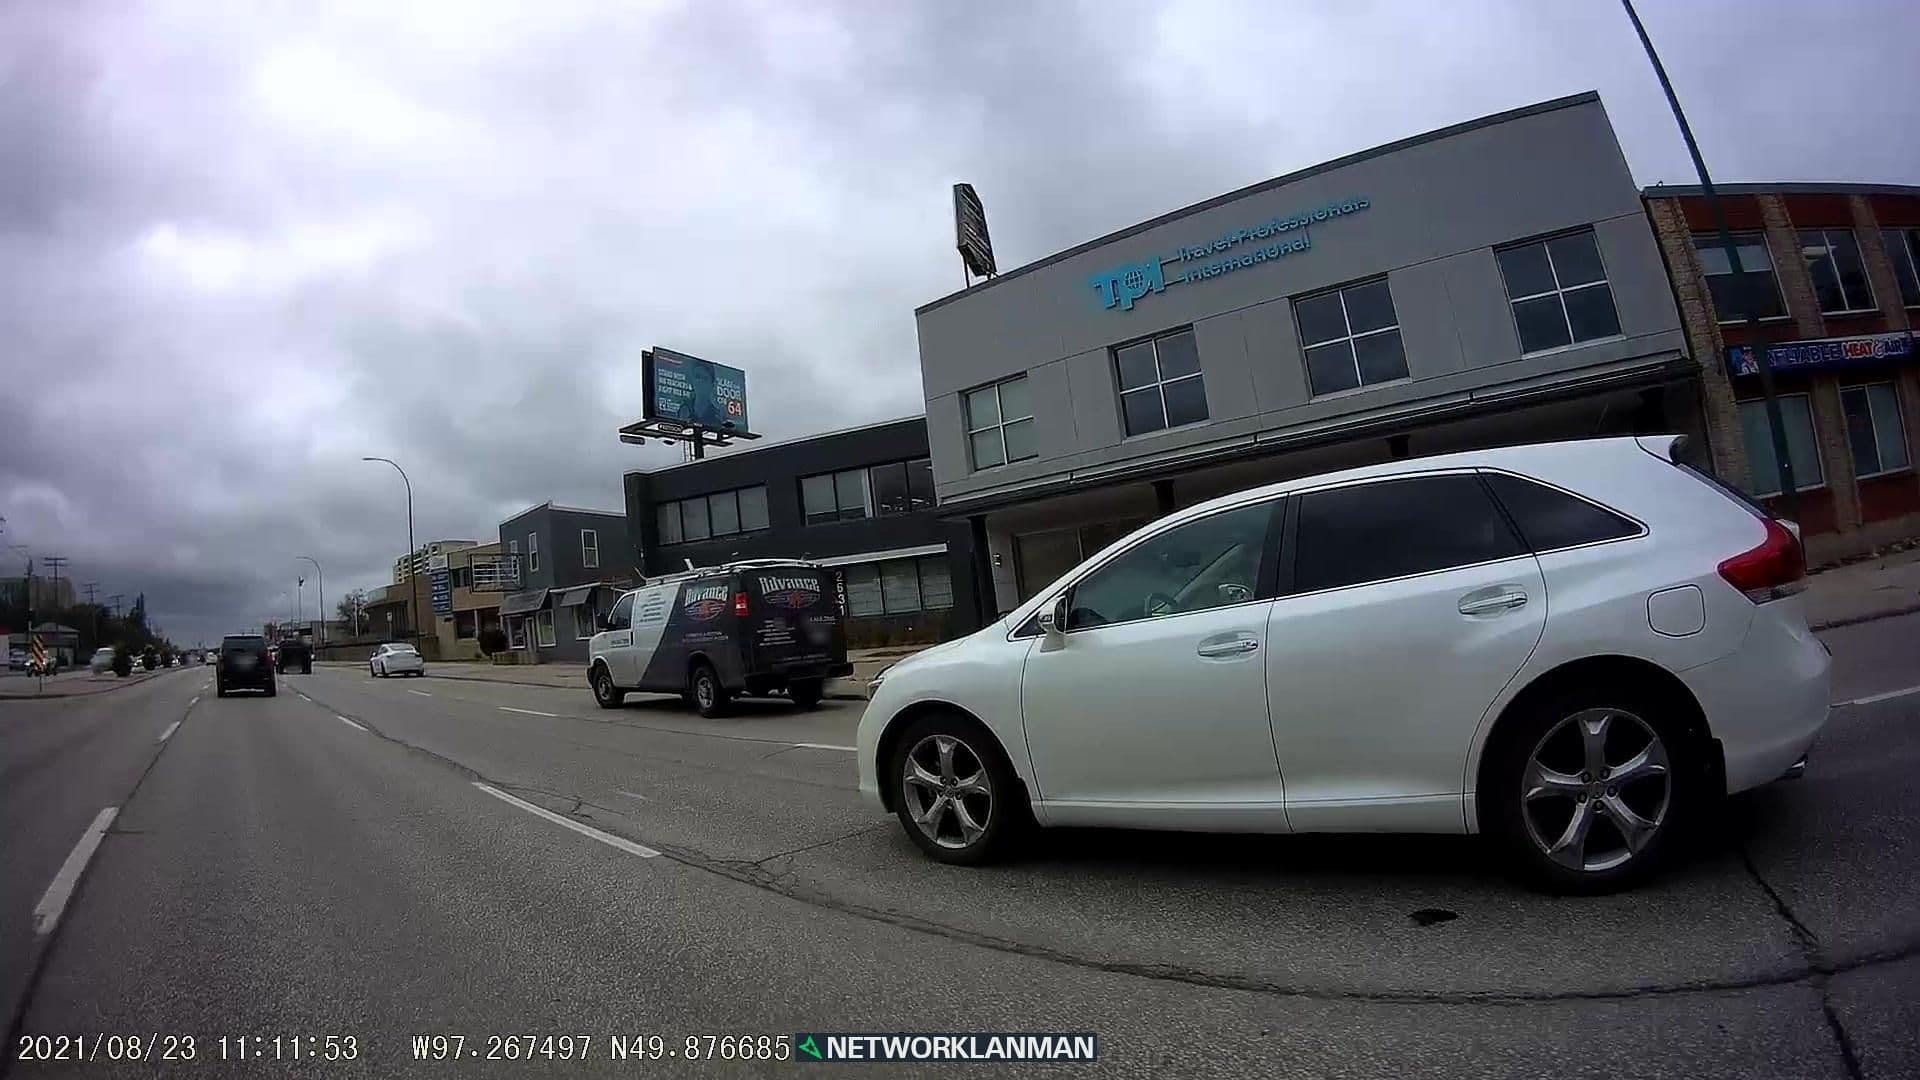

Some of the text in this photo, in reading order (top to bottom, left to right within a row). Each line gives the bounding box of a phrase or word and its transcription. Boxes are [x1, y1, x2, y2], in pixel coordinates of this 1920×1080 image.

[1841, 339, 1873, 360] HEAT
[716, 386, 741, 400] DOOR
[728, 401, 742, 416] 64
[835, 570, 846, 617] 2631
